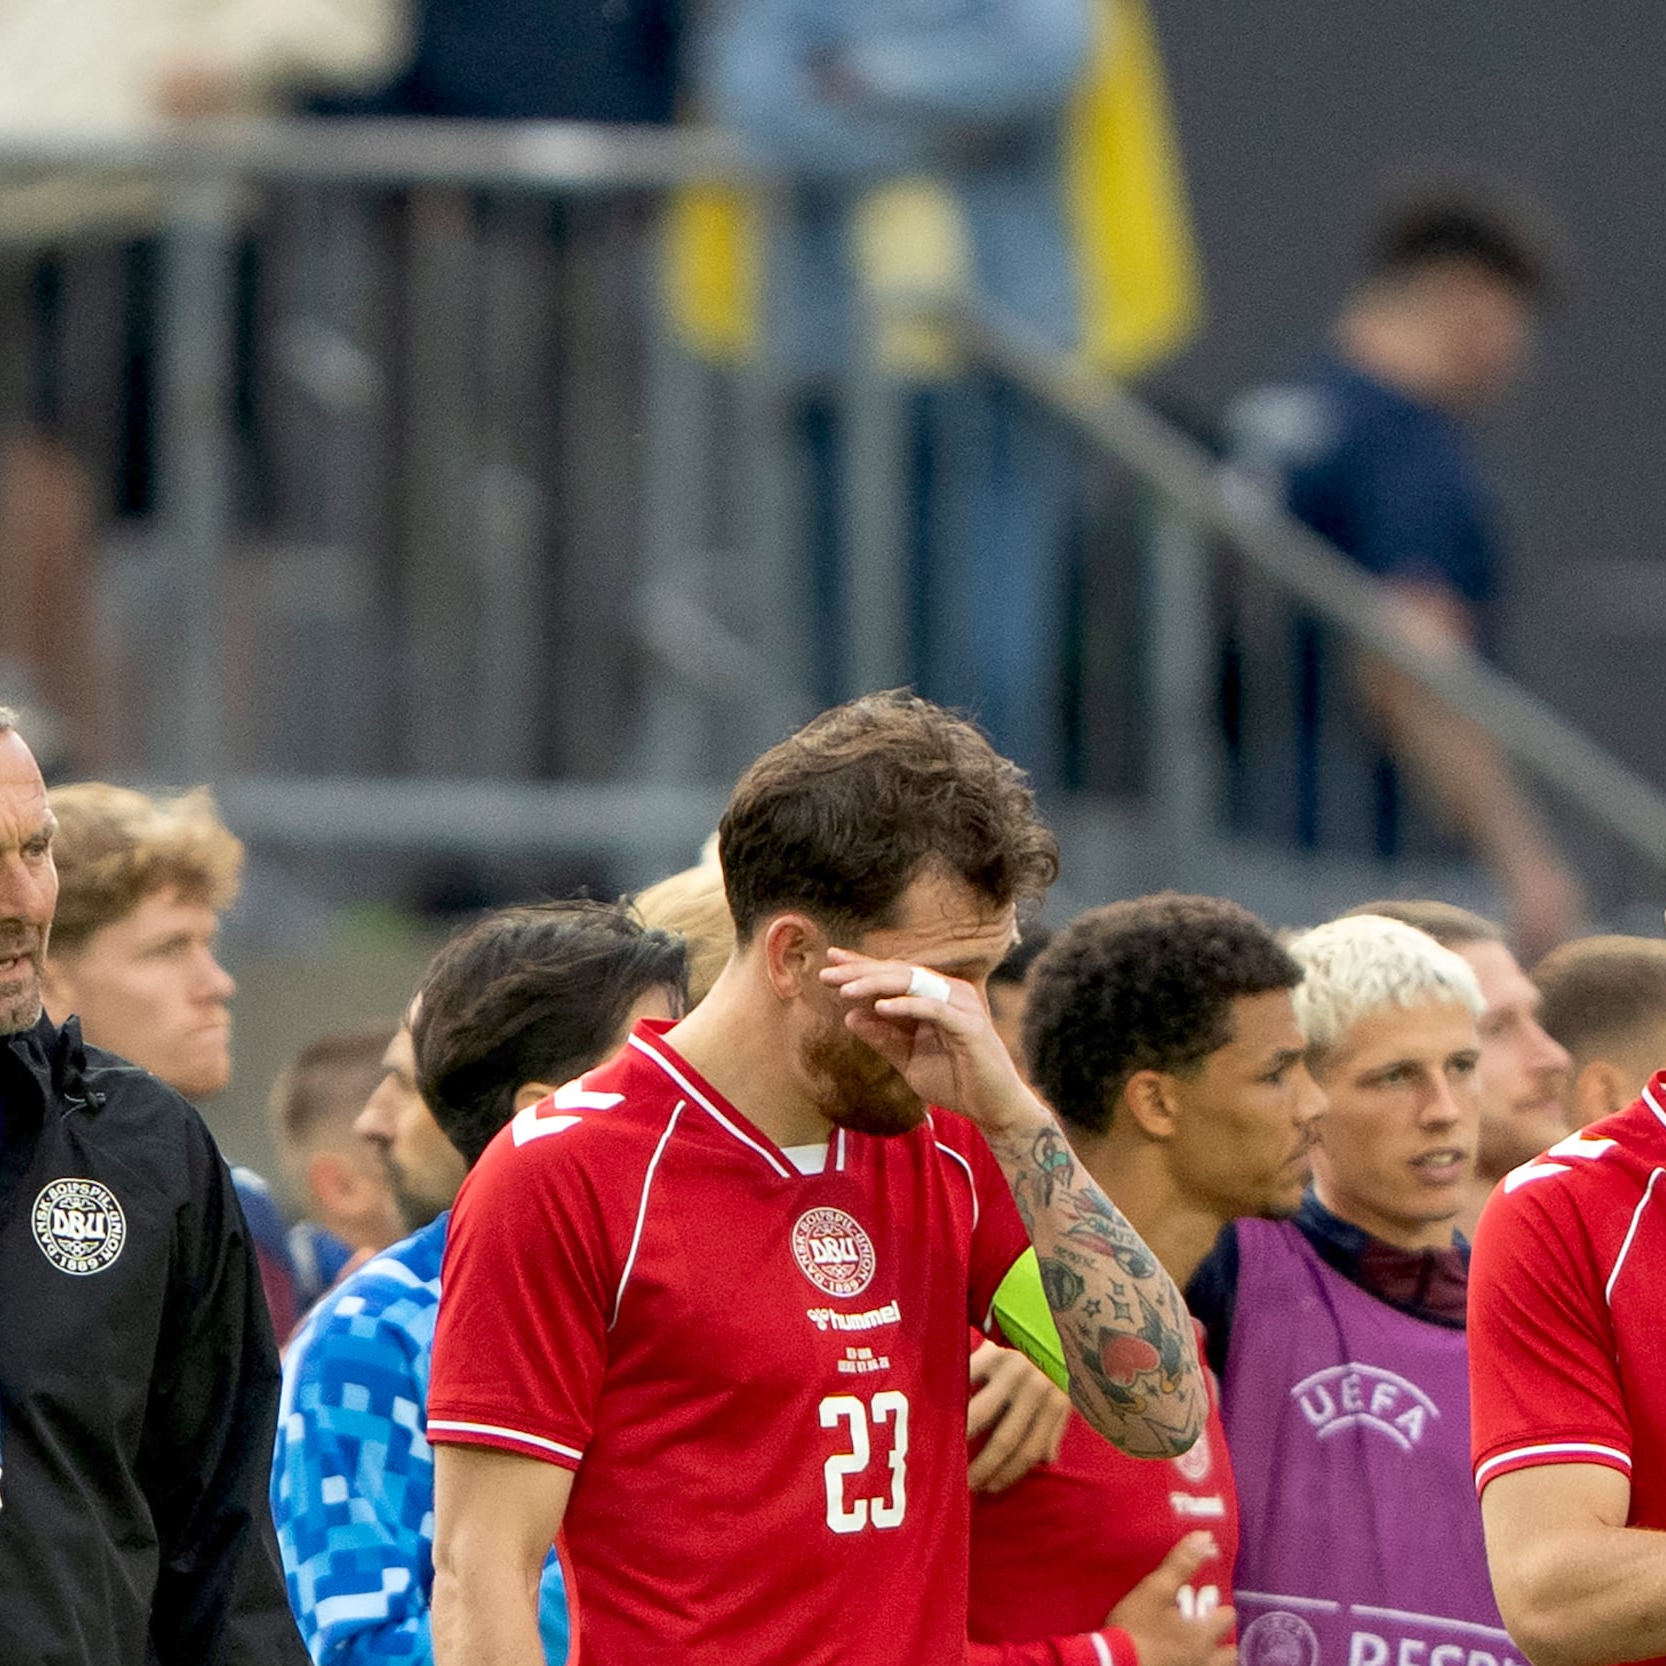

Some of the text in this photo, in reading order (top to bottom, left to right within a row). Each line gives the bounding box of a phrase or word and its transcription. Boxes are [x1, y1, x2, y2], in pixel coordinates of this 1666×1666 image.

[52, 1208, 107, 1240] DBU
[60, 1258, 99, 1272] 1889
[808, 1236, 859, 1264] DBU
[829, 1300, 902, 1331] hummel
[1299, 1372, 1426, 1442] UEFA
[818, 1390, 910, 1534] 23
